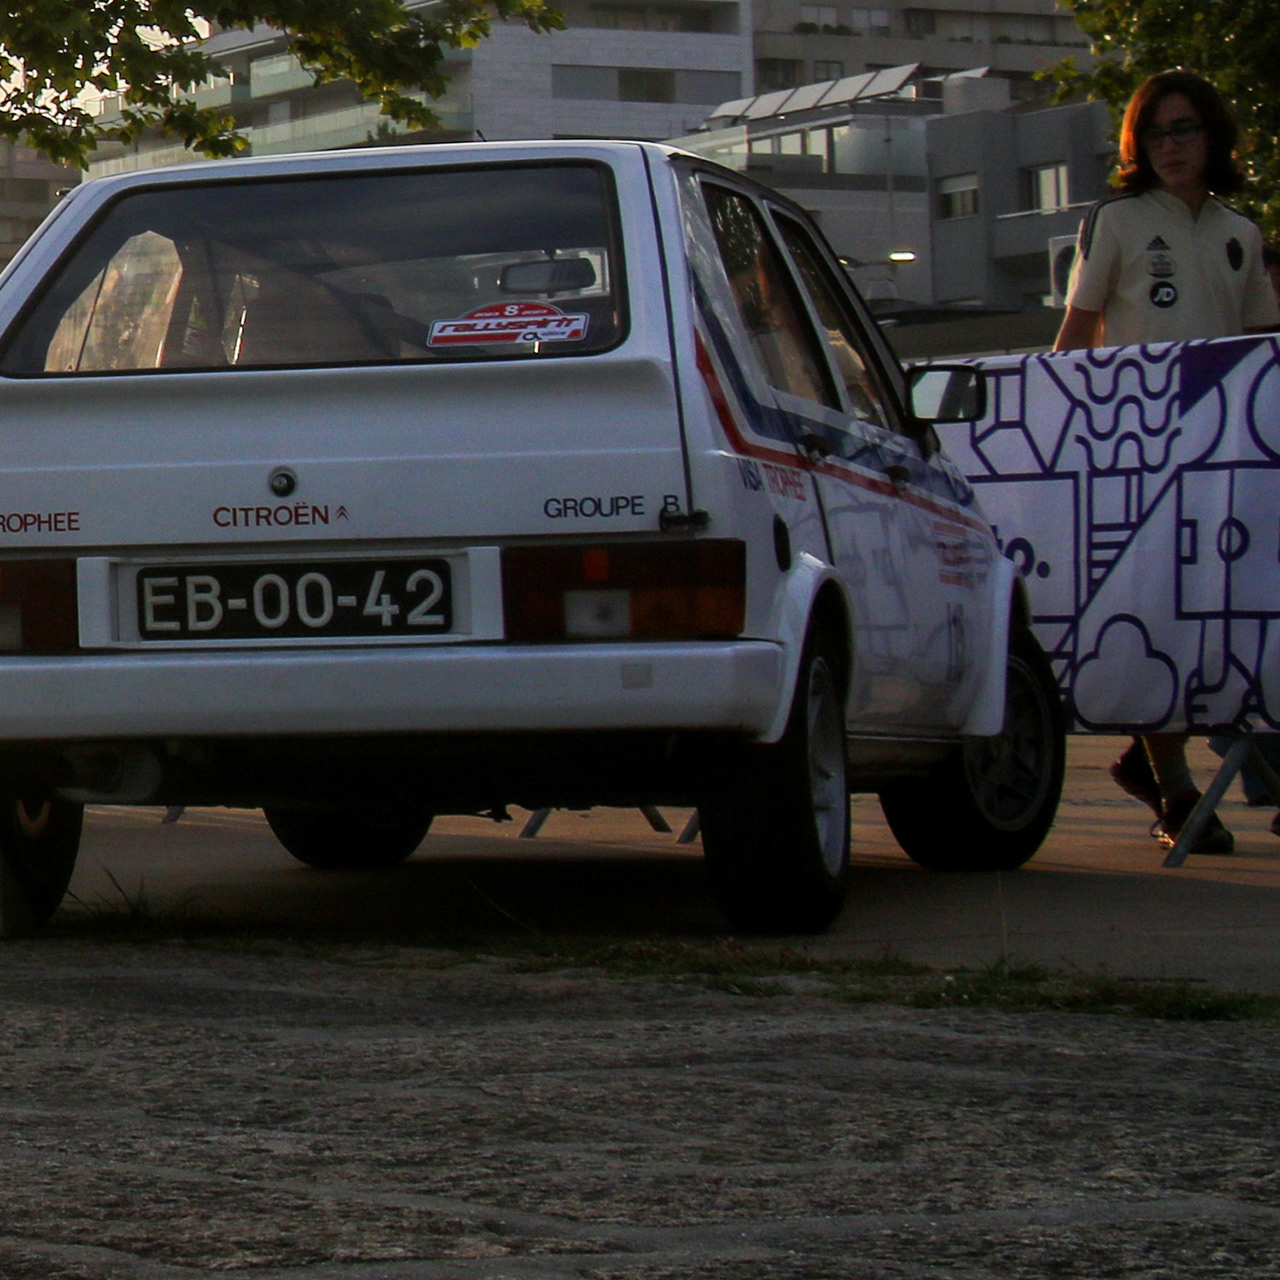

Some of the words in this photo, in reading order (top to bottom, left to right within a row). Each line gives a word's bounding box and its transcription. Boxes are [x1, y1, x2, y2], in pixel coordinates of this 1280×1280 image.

[213, 502, 330, 527] CITROËN
[544, 496, 644, 518] GROUPE
[663, 495, 680, 513] B
[143, 570, 445, 632] EB-00-42
